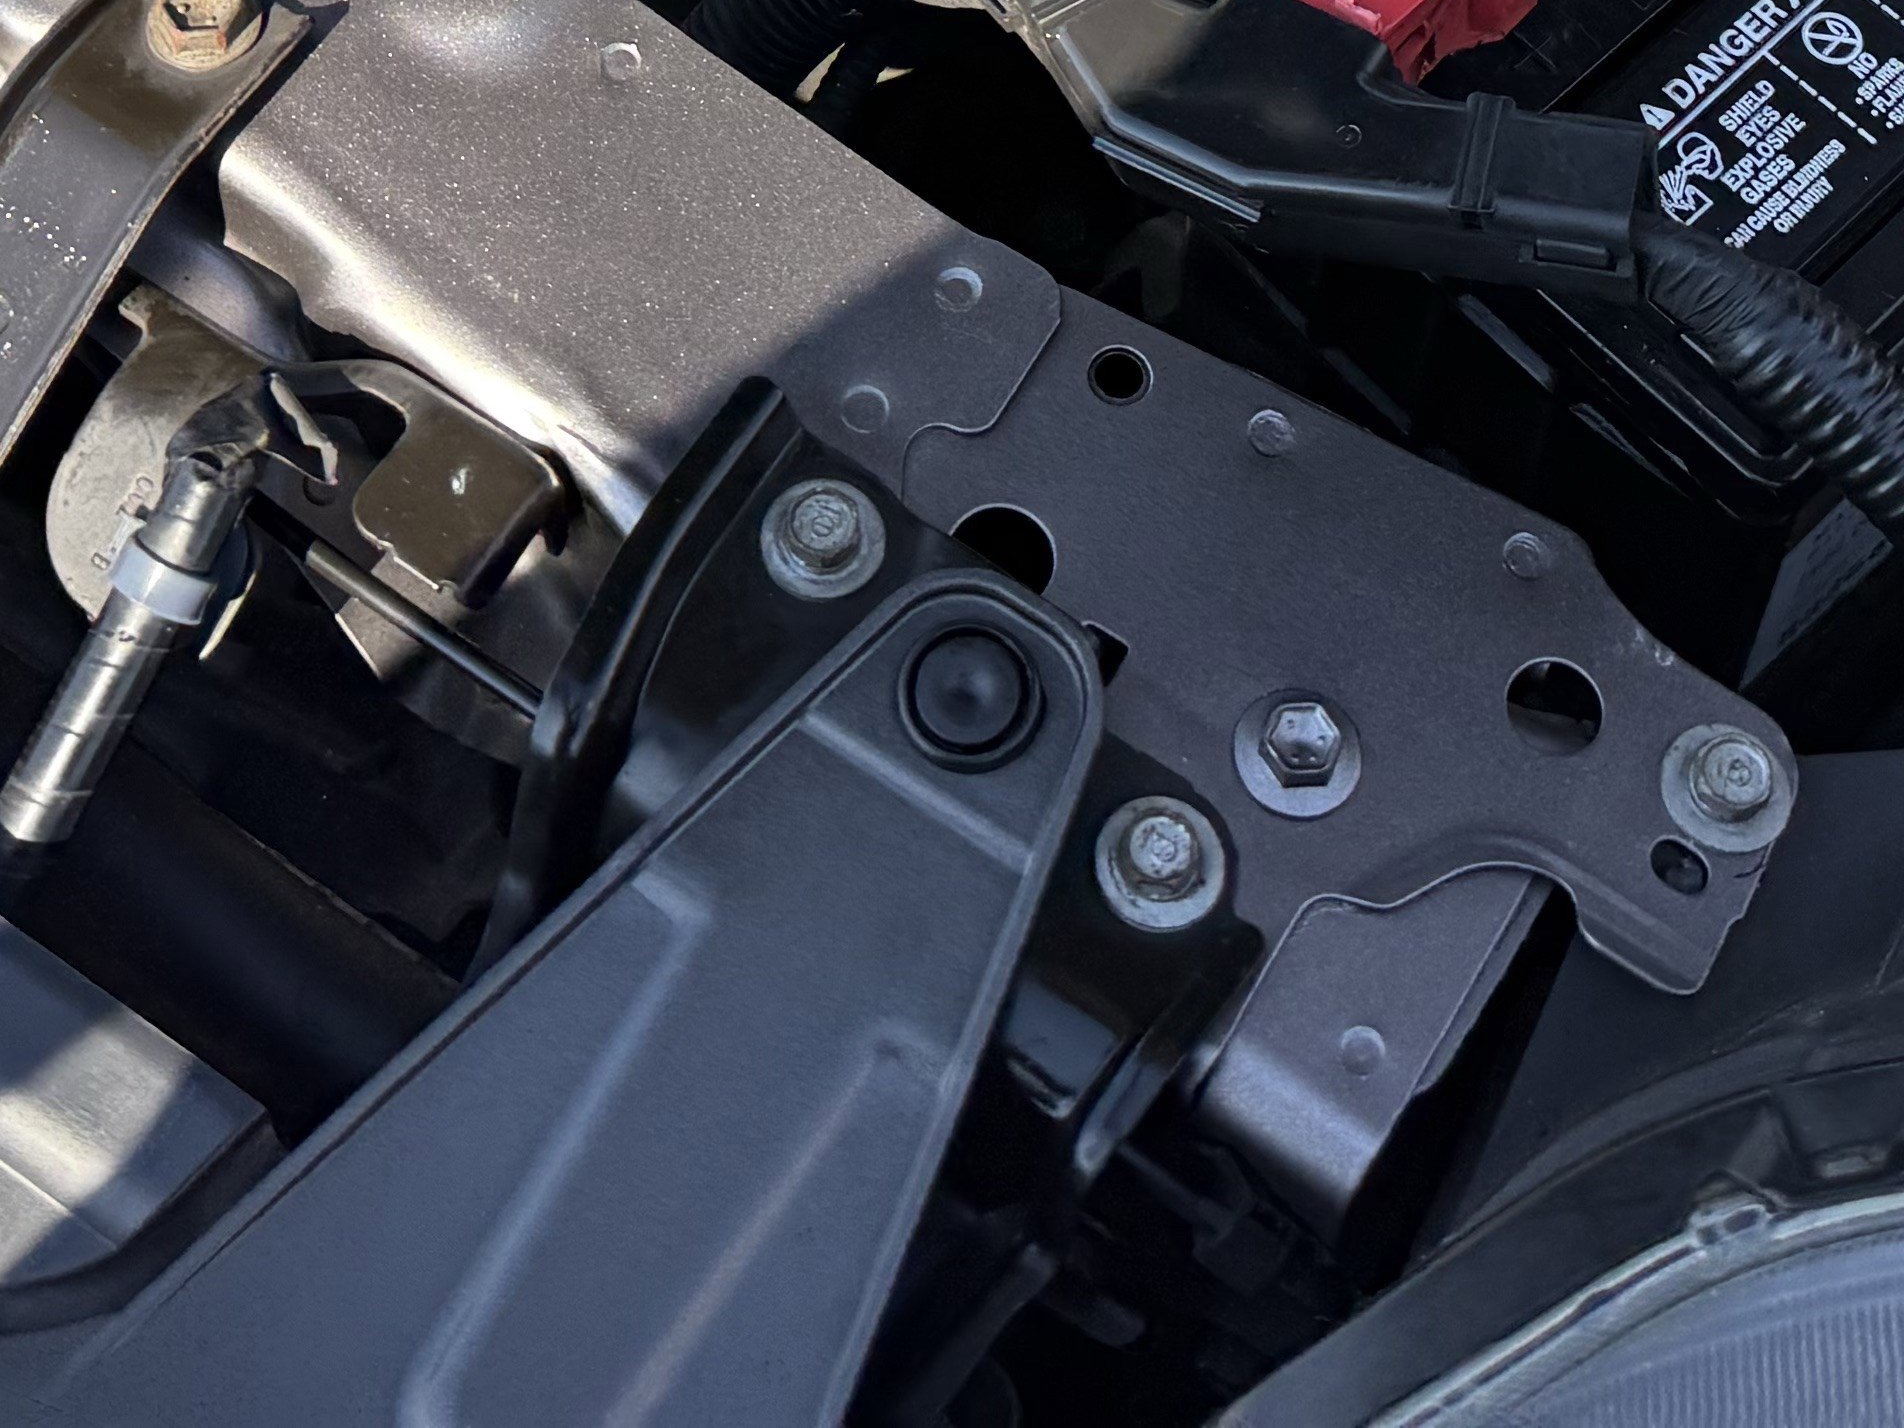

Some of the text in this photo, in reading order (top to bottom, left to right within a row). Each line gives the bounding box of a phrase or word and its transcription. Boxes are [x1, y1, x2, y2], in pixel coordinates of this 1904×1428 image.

[1848, 52, 1878, 80] NO
[1718, 80, 1775, 132] SHIELD
[1735, 104, 1782, 148] EYES
[1721, 112, 1806, 191] EXPLOSIVE
[1740, 154, 1795, 206] GASES
[1749, 186, 1790, 230] CAUSE
[1784, 139, 1846, 198] BLINDNESS
[1773, 175, 1833, 233] OR INJURY
